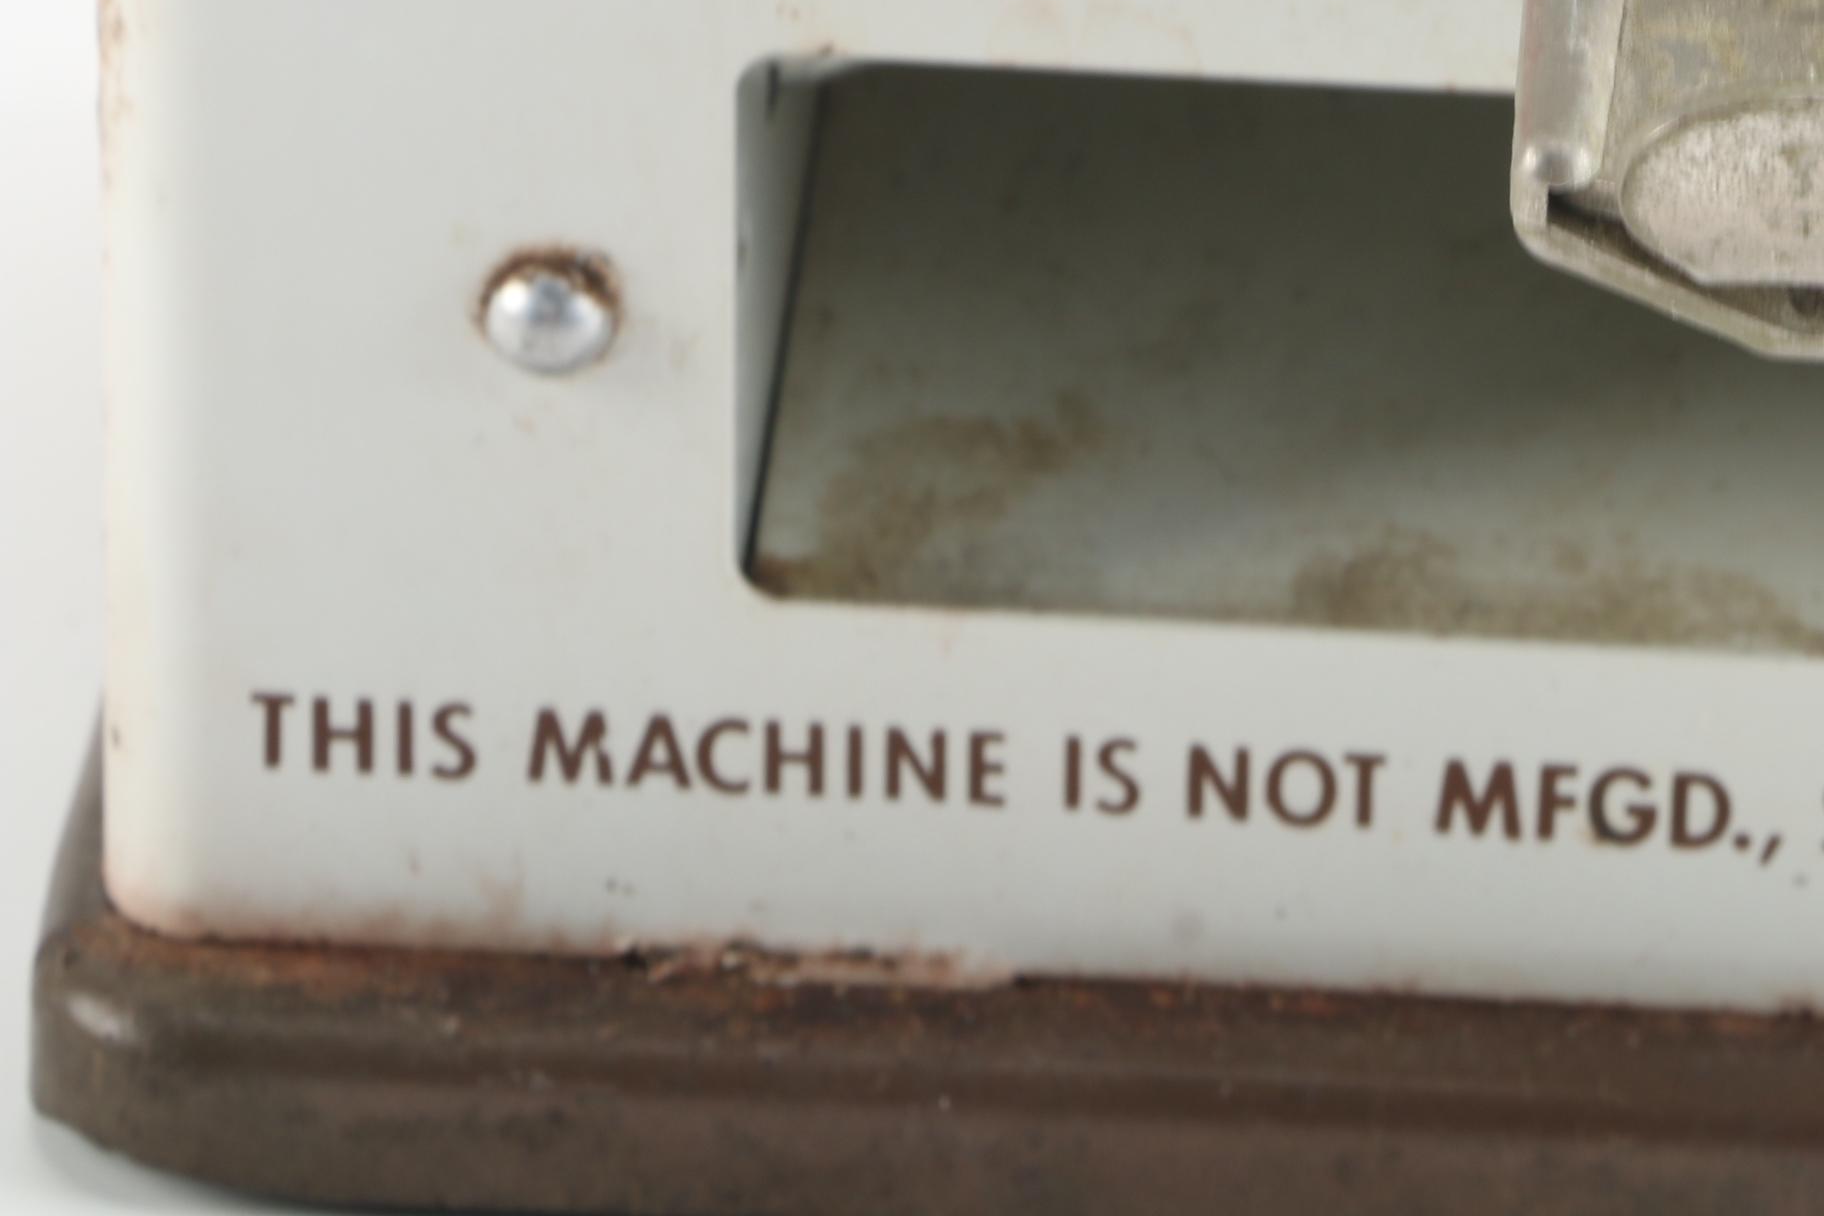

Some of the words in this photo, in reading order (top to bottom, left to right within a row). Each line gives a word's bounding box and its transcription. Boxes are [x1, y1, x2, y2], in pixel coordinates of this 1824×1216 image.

[249, 690, 479, 784] THIS
[525, 705, 1007, 810] MACHINE
[1061, 733, 1143, 818] IS
[1184, 741, 1388, 844] NOT
[1432, 756, 1783, 867] MFGD.,
